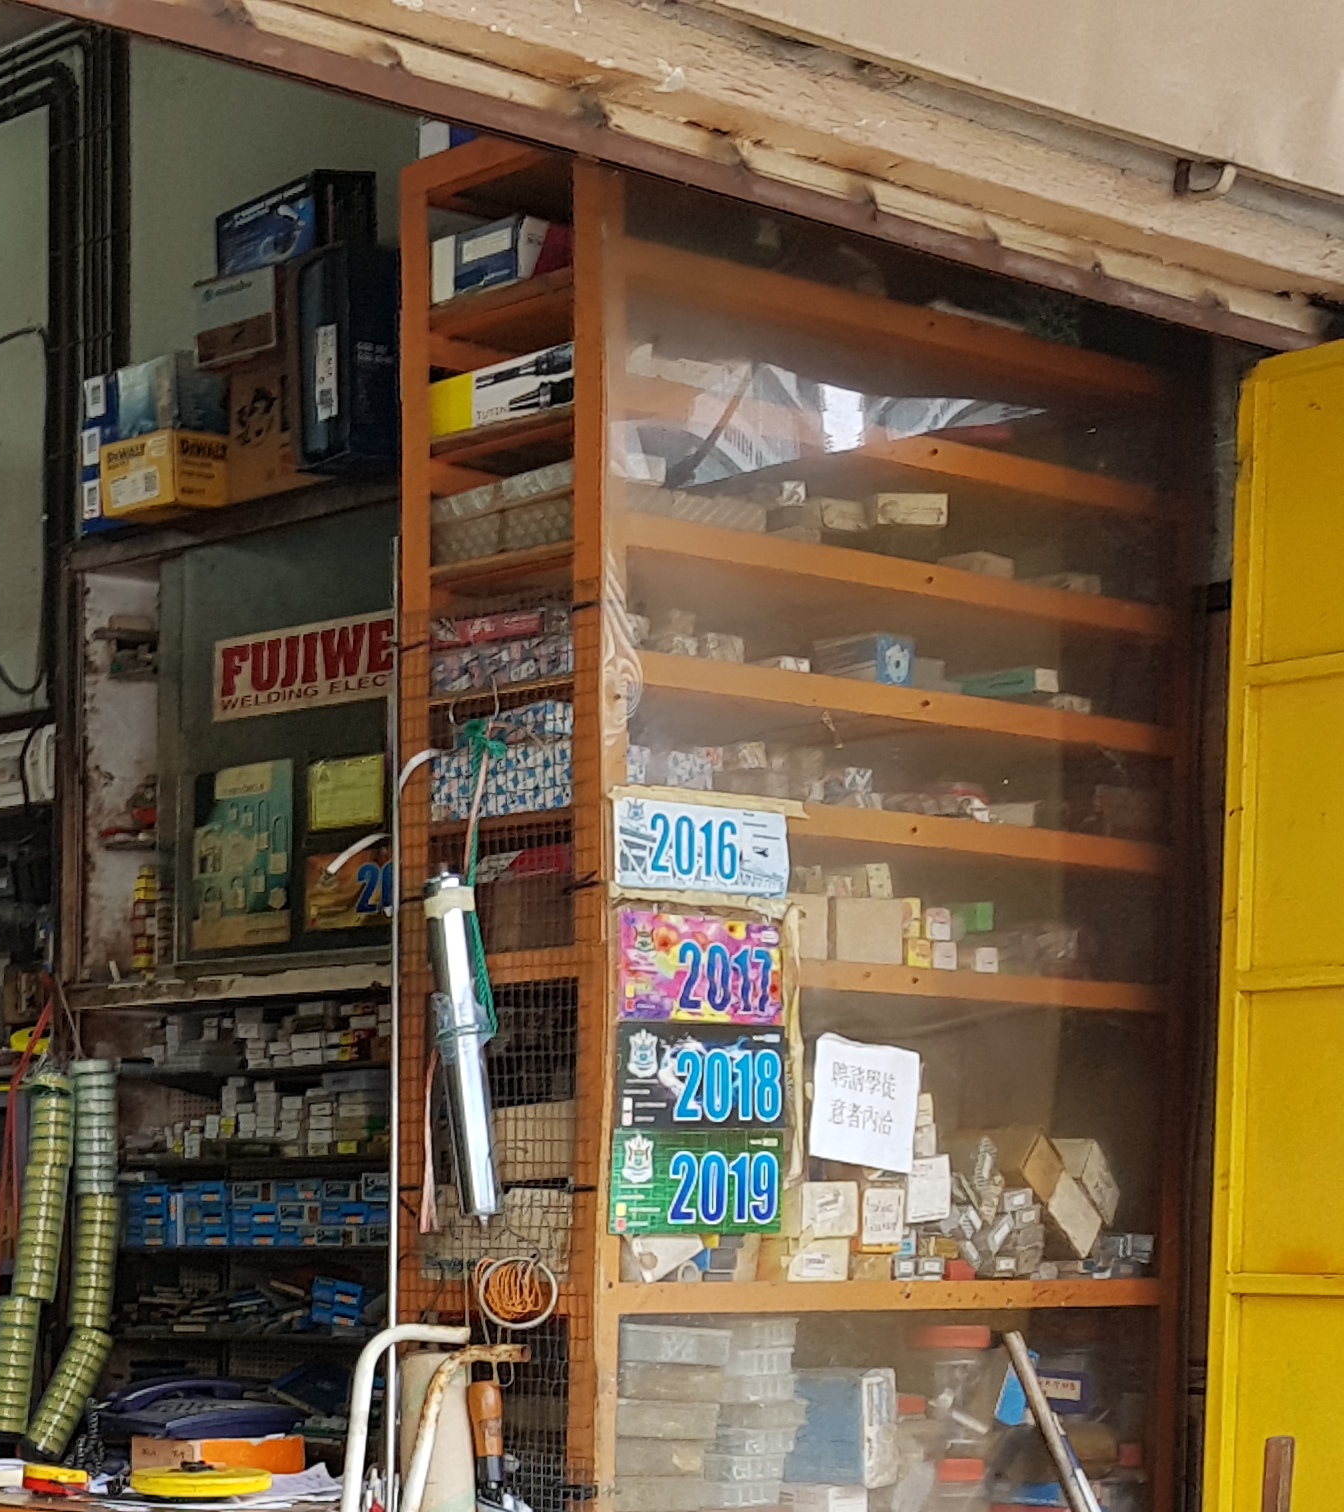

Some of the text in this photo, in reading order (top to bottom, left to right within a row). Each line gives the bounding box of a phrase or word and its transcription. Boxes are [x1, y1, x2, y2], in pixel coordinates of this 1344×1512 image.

[221, 618, 394, 698] FUJIWE
[221, 672, 392, 712] WELDING ELEC
[649, 811, 739, 883] 2016
[678, 938, 774, 1018] 2017
[673, 1048, 782, 1123] 2018
[668, 1150, 780, 1225] 2019
